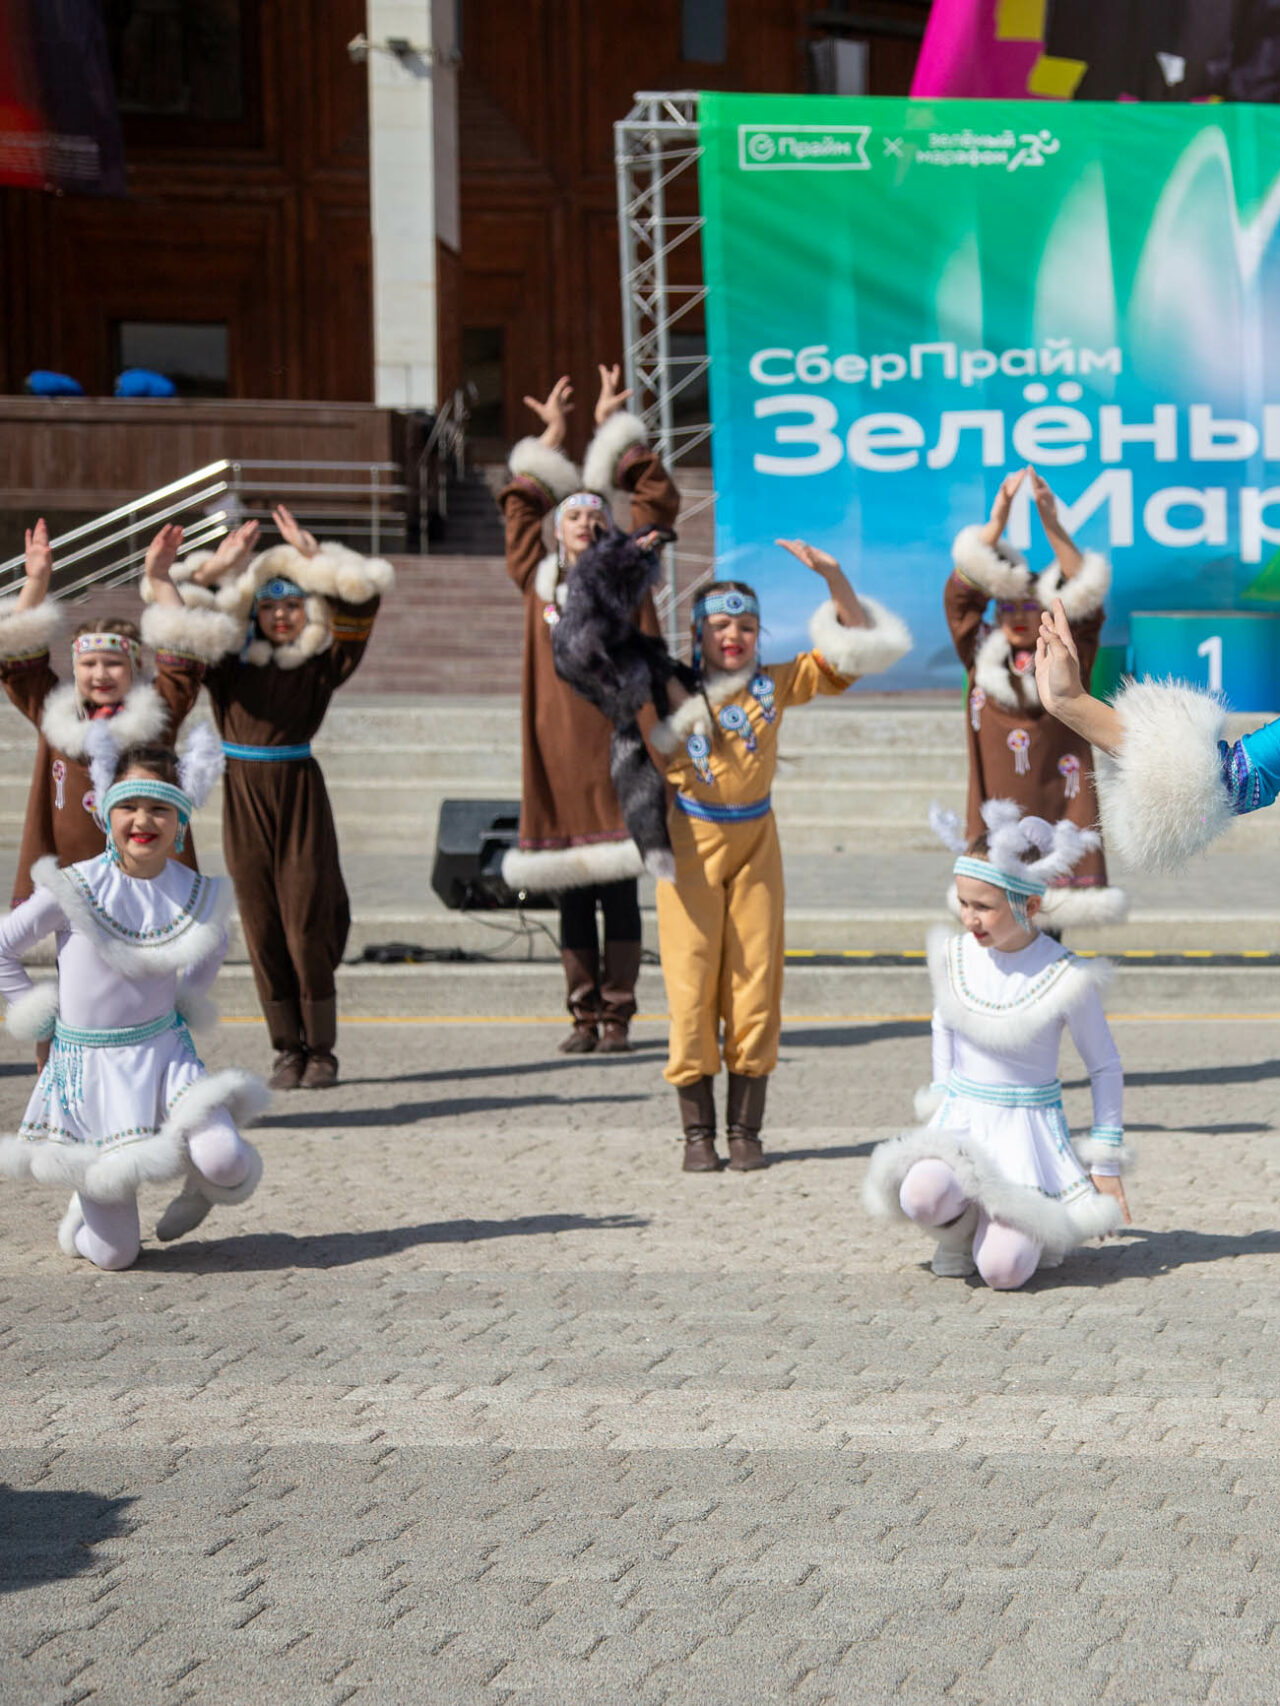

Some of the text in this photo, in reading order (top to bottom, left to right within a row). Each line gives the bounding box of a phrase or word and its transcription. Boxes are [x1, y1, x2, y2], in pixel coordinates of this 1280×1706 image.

[778, 136, 852, 159] Прайм
[748, 338, 1123, 389] СберПрайм
[1197, 635, 1223, 691] 1
